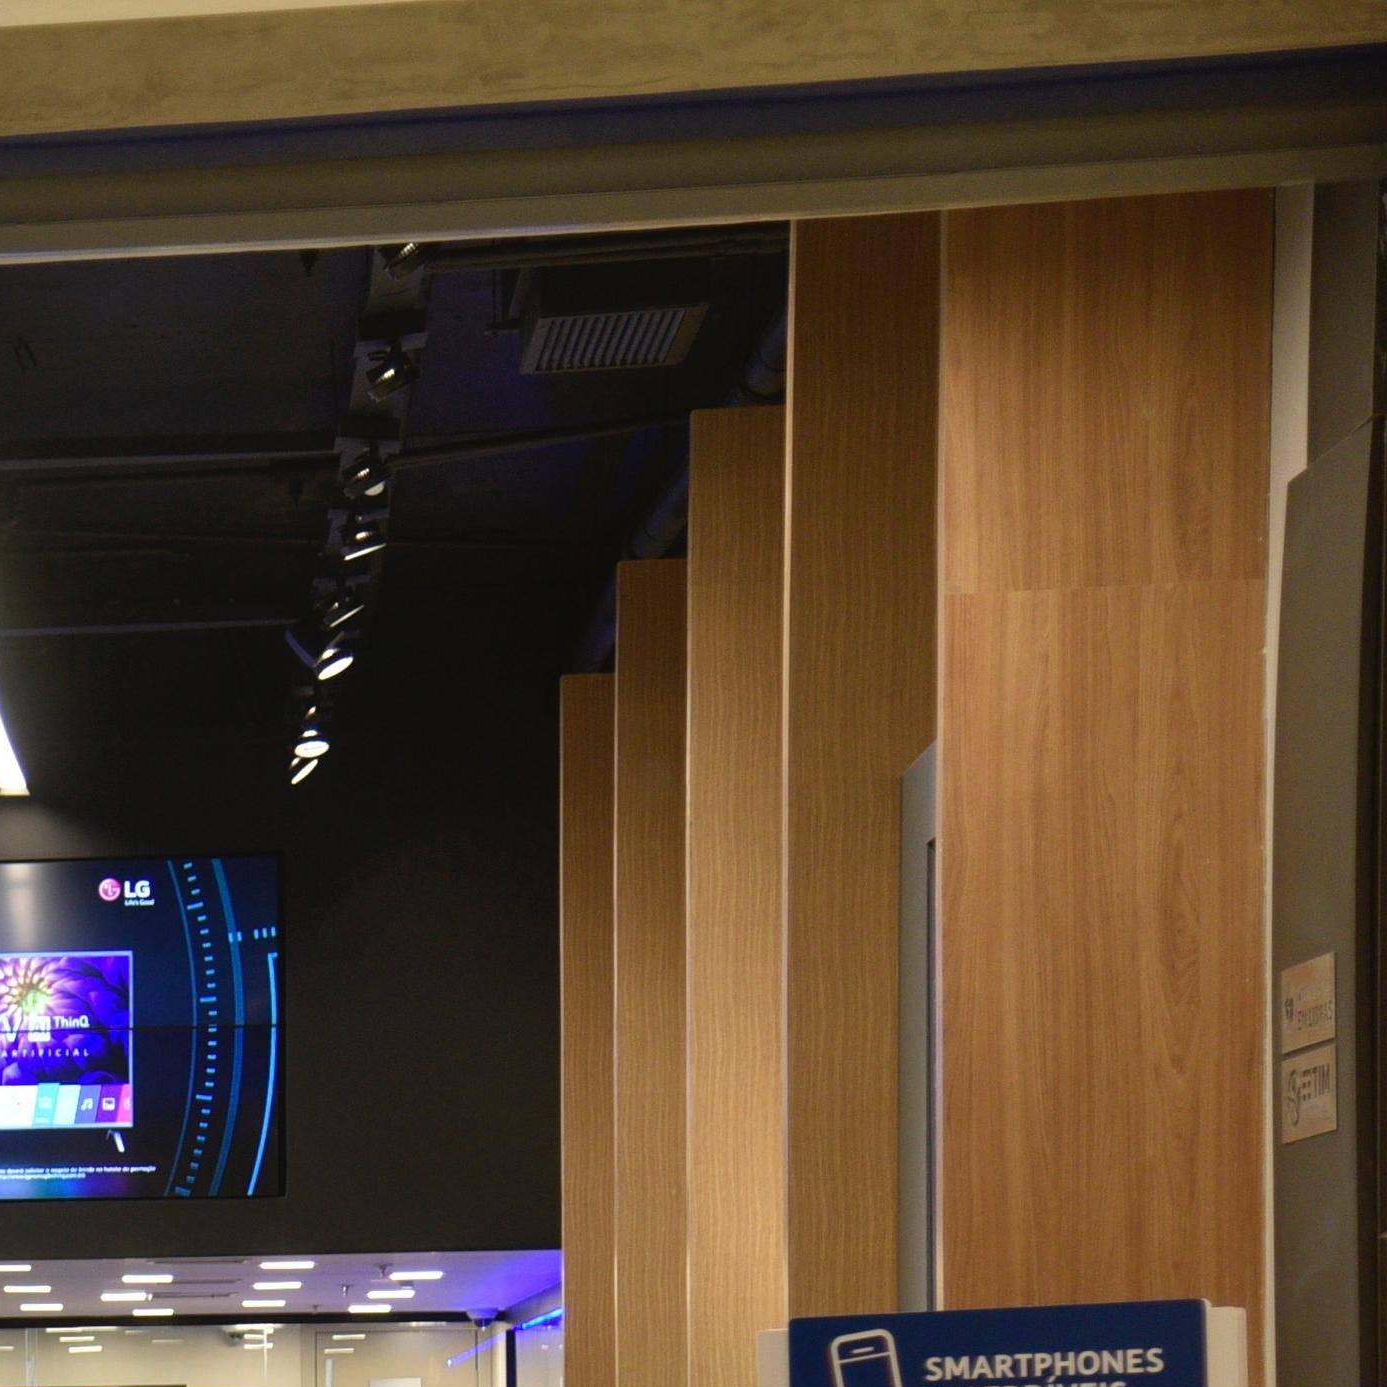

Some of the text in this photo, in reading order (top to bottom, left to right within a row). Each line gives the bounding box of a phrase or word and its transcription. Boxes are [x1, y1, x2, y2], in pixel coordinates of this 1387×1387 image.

[124, 881, 150, 898] LG
[53, 1015, 89, 1029] ThinQ
[1, 1048, 89, 1059] ARTIFICIAL
[926, 1348, 1164, 1382] SMARTPHONES
